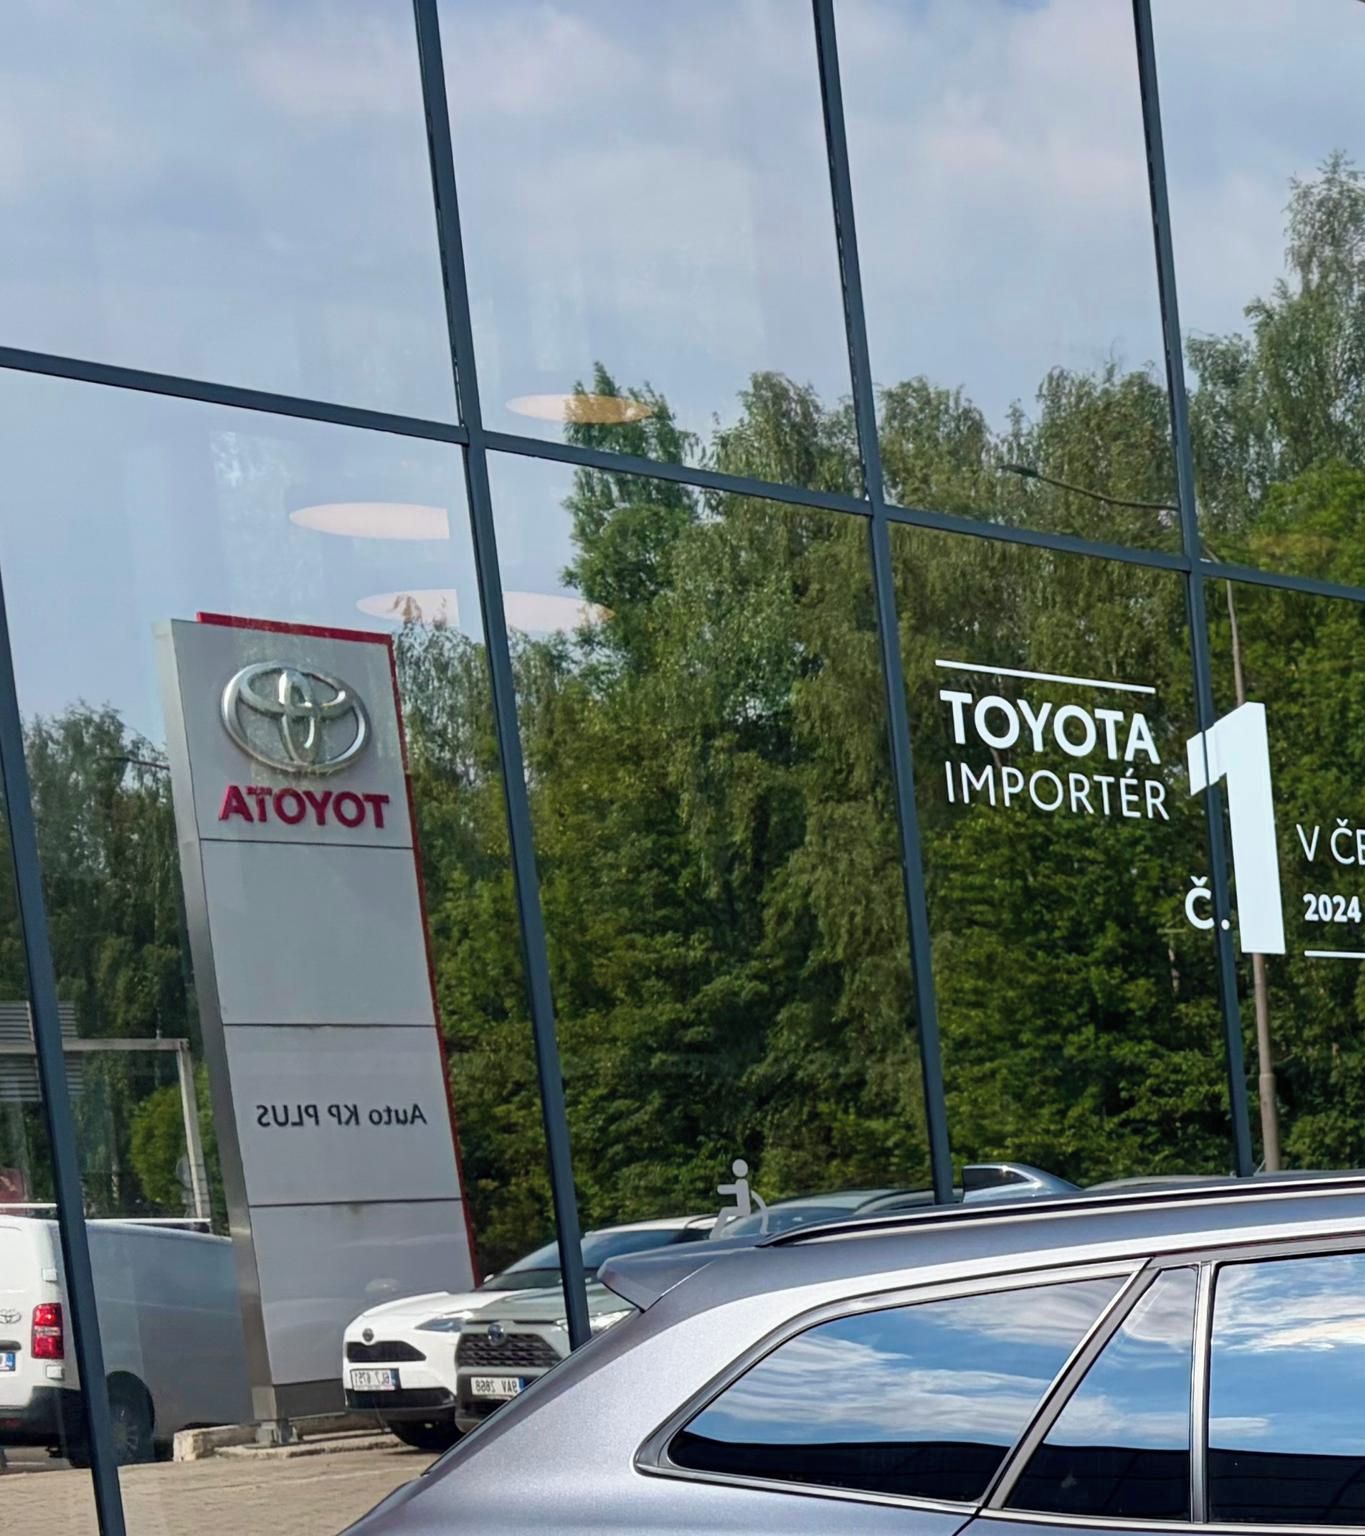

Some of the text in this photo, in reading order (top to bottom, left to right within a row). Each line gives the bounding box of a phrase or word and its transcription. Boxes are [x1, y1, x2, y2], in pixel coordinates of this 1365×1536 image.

[939, 689, 1161, 765] TOYOTA
[945, 760, 1169, 821] IMPORTÉR
[1186, 701, 1286, 955] 1
[1296, 823, 1320, 862] V
[1303, 893, 1362, 923] 2024
